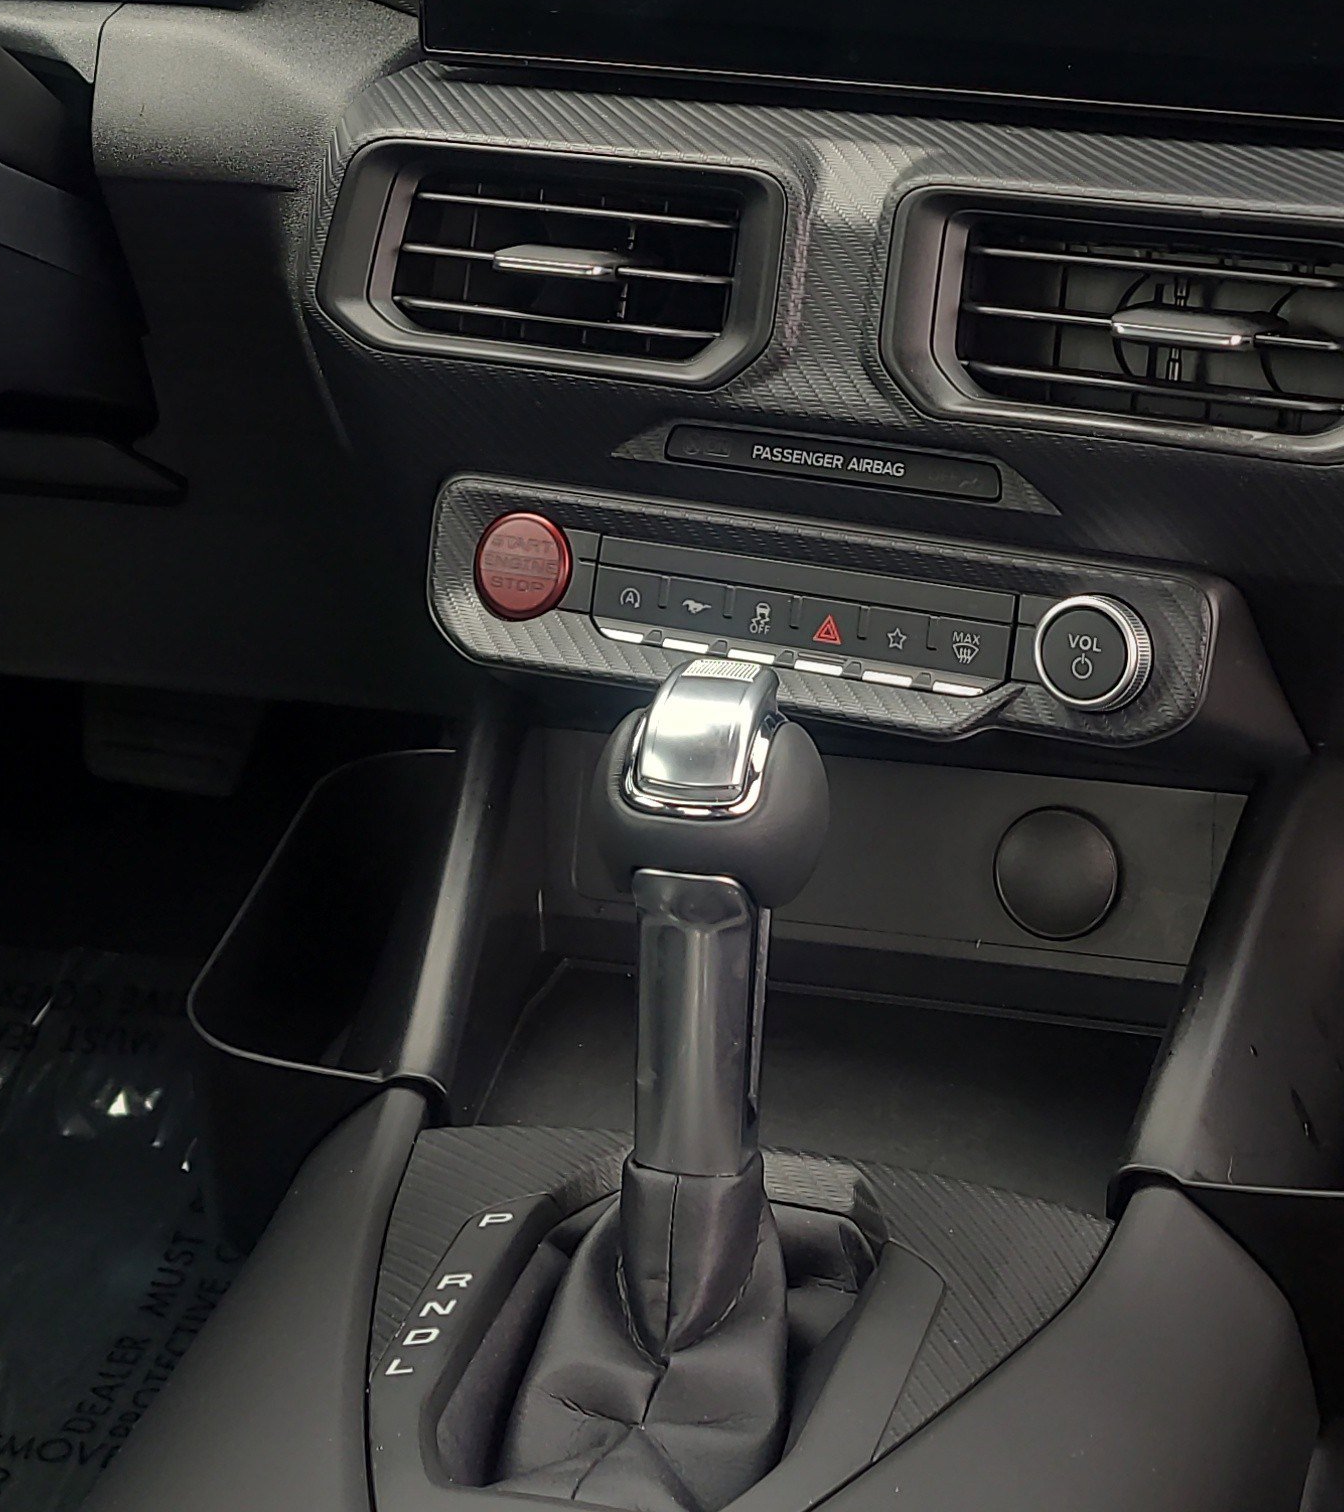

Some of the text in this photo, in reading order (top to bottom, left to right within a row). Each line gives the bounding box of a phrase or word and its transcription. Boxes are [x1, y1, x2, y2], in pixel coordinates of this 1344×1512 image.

[752, 445, 843, 469] PASSENGER
[847, 458, 905, 477] AIRBAG
[490, 534, 555, 554] START
[484, 553, 558, 575] ENGINE
[490, 575, 546, 592] STOP
[749, 623, 771, 636] OFF
[952, 631, 981, 645] MAX
[1068, 633, 1102, 653] VOL
[478, 1212, 514, 1228] P
[436, 1273, 473, 1290] R
[419, 1299, 456, 1318] N
[402, 1327, 440, 1345] D
[384, 1358, 414, 1376] L
